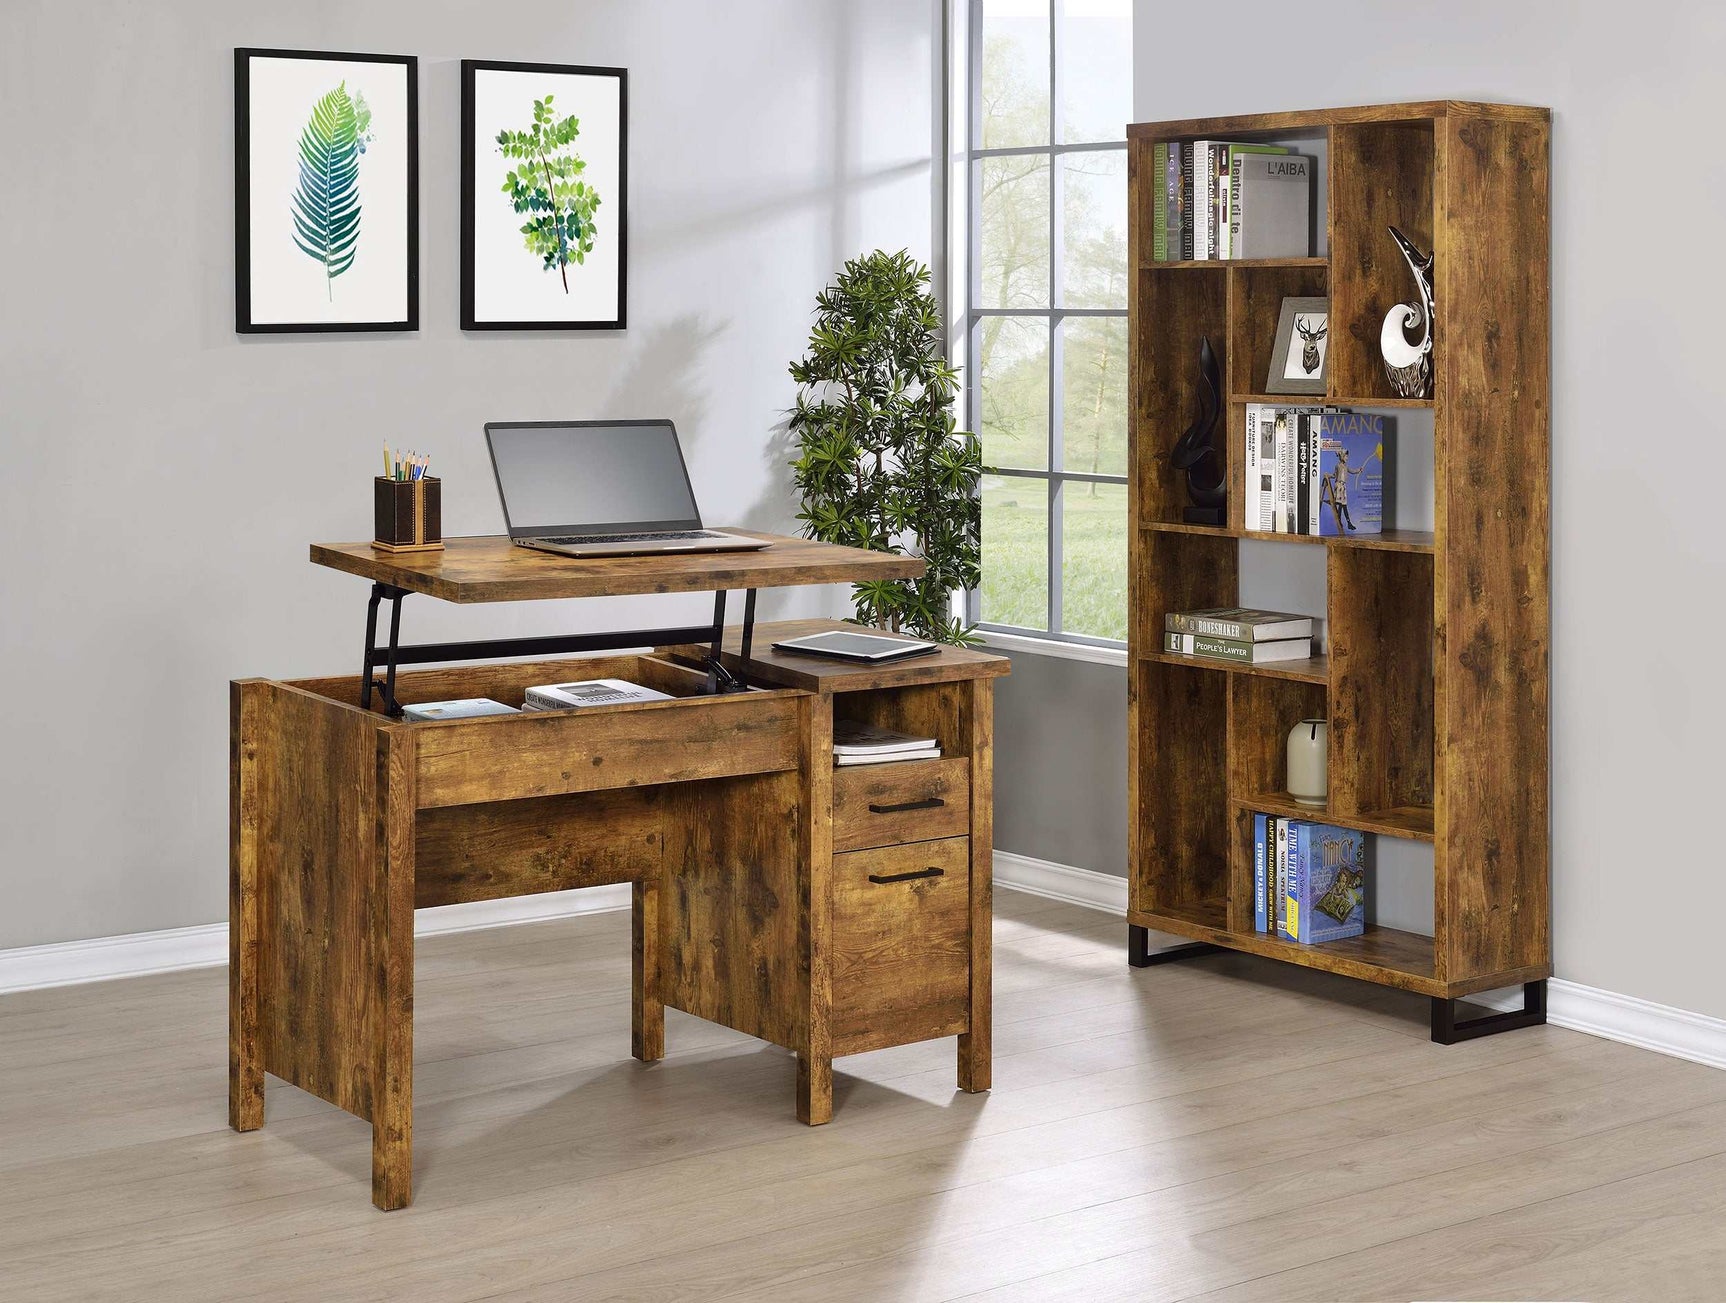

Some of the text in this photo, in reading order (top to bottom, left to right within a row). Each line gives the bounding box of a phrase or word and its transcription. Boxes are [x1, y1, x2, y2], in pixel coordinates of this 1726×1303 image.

[1268, 162, 1306, 176] L'AIBA
[1230, 160, 1242, 234] Dentro di te
[1198, 620, 1240, 638] BONESHAKER
[1288, 828, 1297, 852] TIME
[1288, 853, 1297, 876] WITH
[1288, 878, 1297, 893] ME
